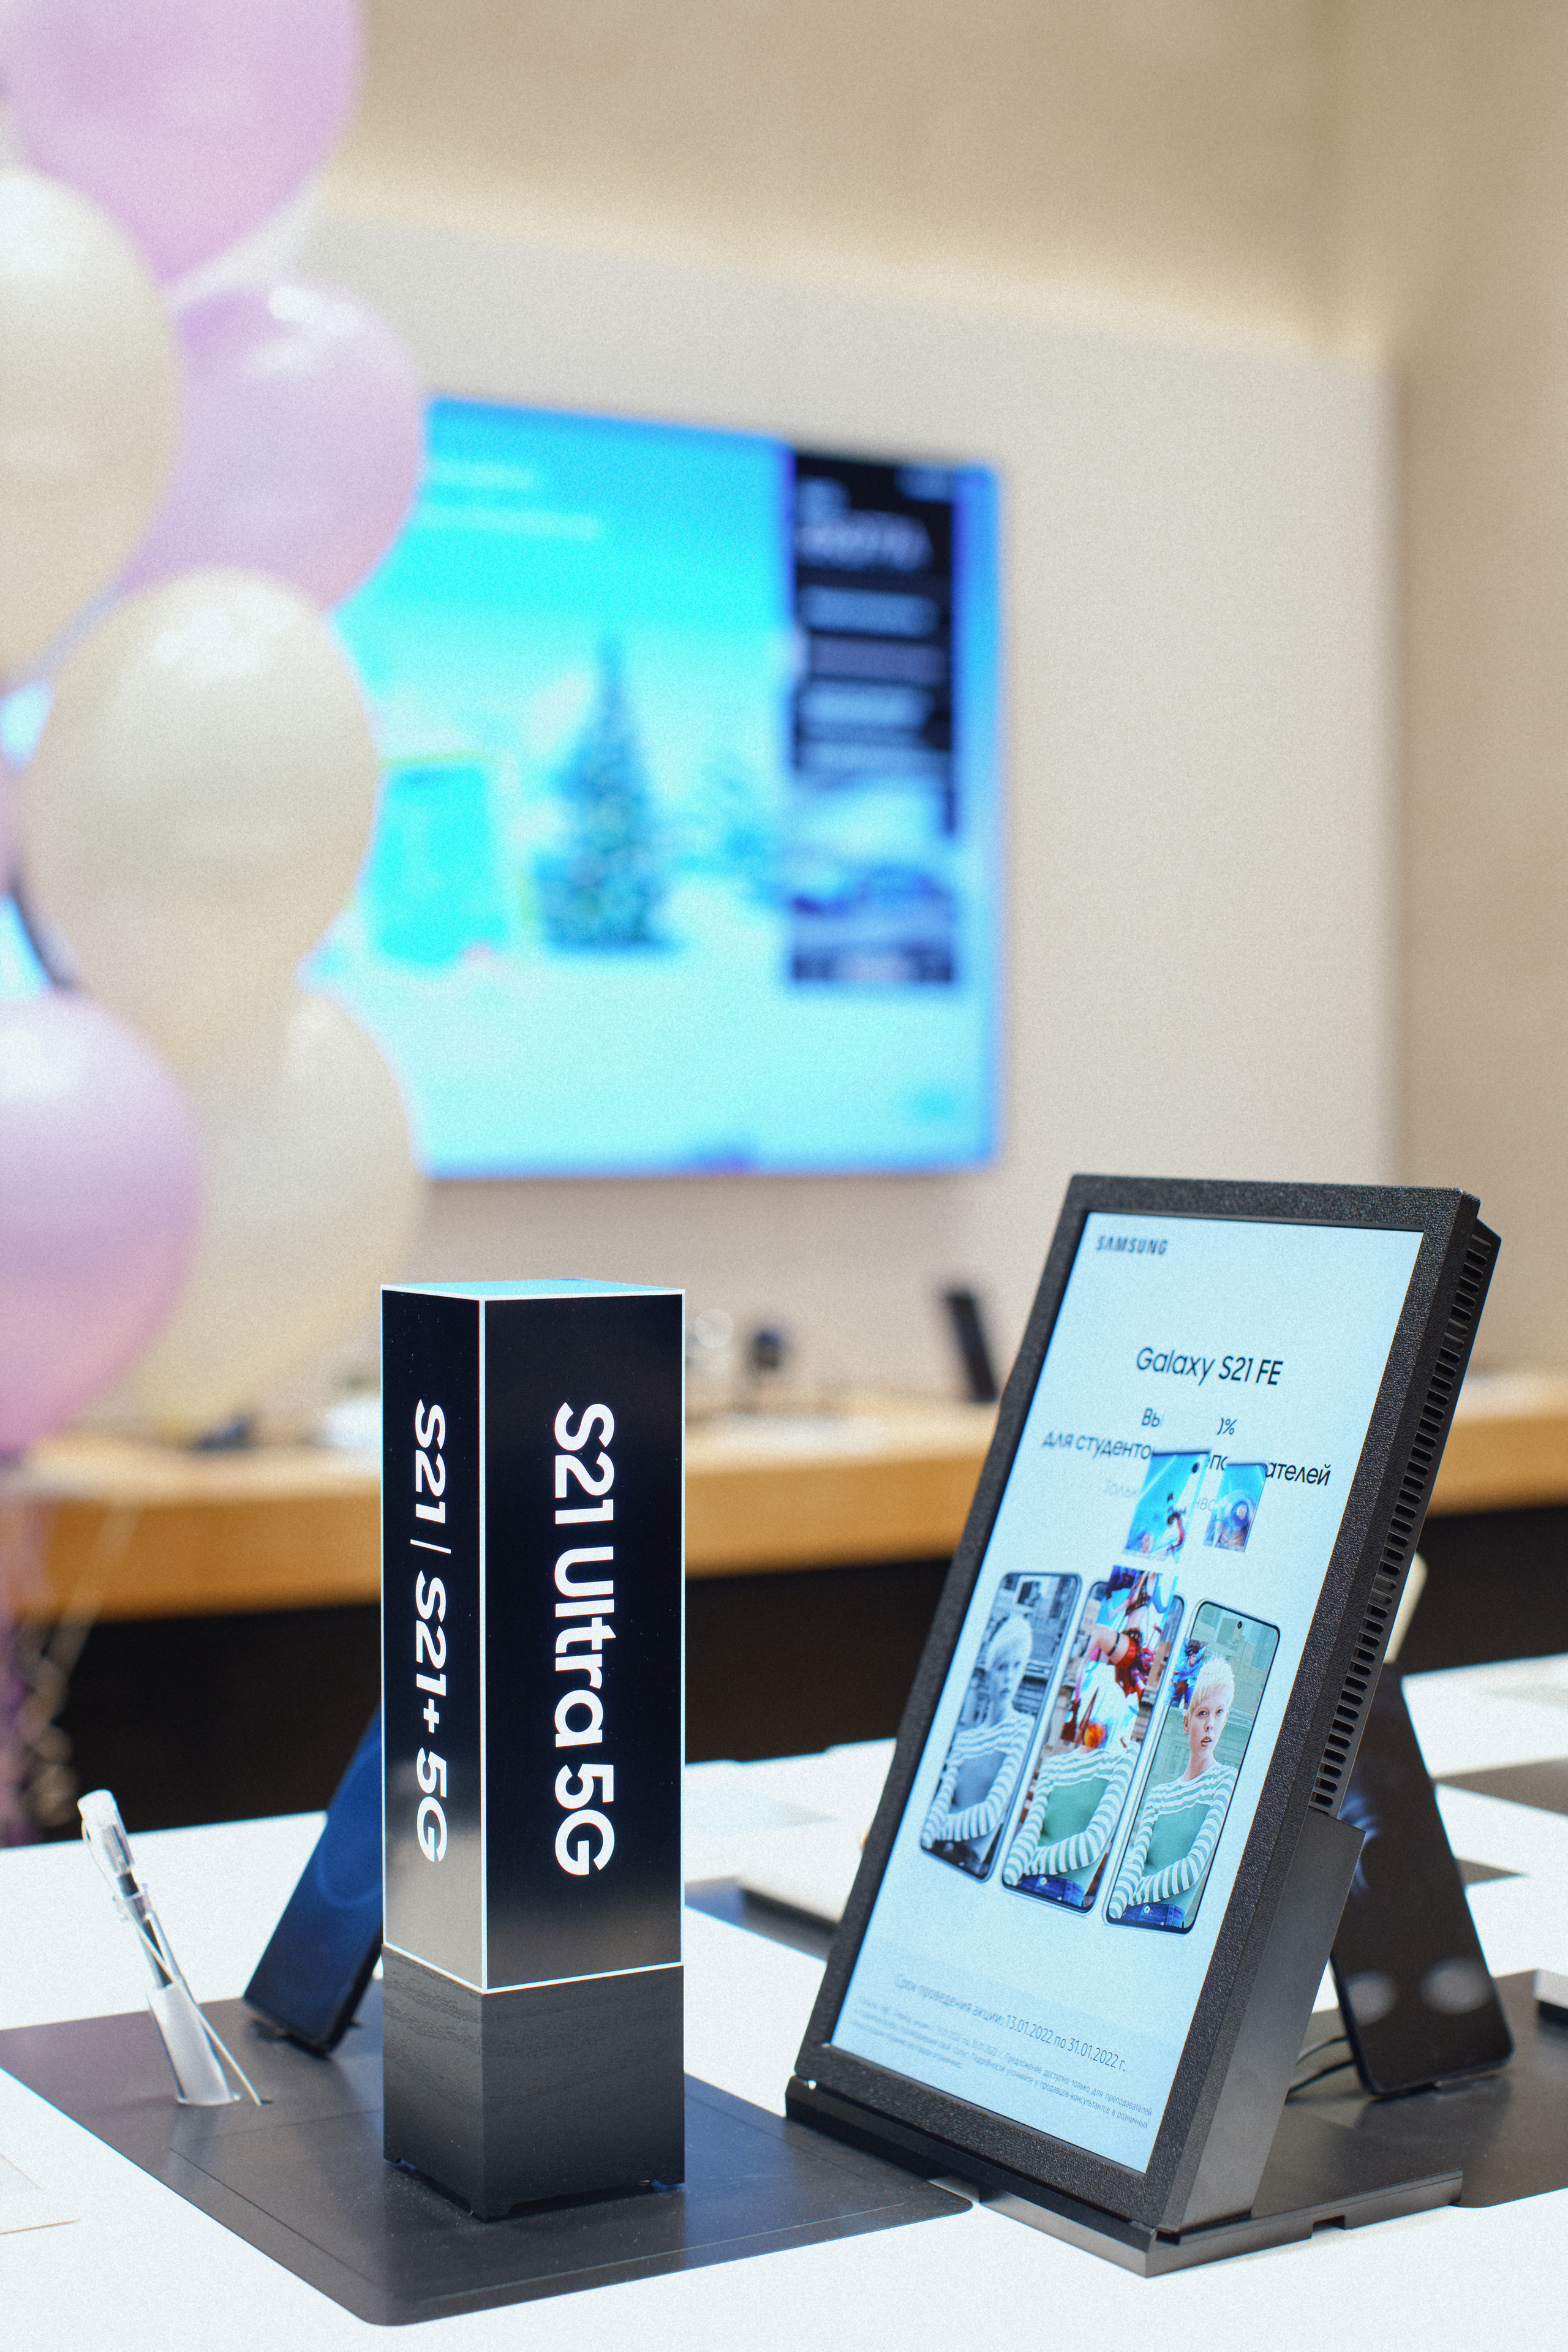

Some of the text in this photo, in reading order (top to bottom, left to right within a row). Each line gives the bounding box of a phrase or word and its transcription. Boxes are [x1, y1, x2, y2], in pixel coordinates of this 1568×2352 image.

[1095, 1234, 1169, 1256] SAMSUNG
[1136, 1346, 1284, 1387] Galaxy S21 FE
[415, 1399, 446, 1524] S21
[1042, 1431, 1074, 1448] для
[1076, 1434, 1152, 1460] студенто
[415, 1570, 447, 1734] S21+
[554, 1402, 617, 1876] S21 Ultra 5G
[416, 1747, 448, 1863] 5G
[1006, 2015, 1054, 2044] 13.01.2022
[1054, 2036, 1066, 2049] по
[1068, 2037, 1118, 2068] 31.01.2022
[1119, 2059, 1126, 2072] г.
[1040, 2081, 1110, 2114] продавцов-консультантов
[1117, 2111, 1148, 2130] розничных
[1043, 2070, 1069, 2084] доступно
[1072, 2079, 1090, 2092] только
[1091, 2088, 1103, 2098] для
[1105, 2093, 1152, 2117] преподавателей
